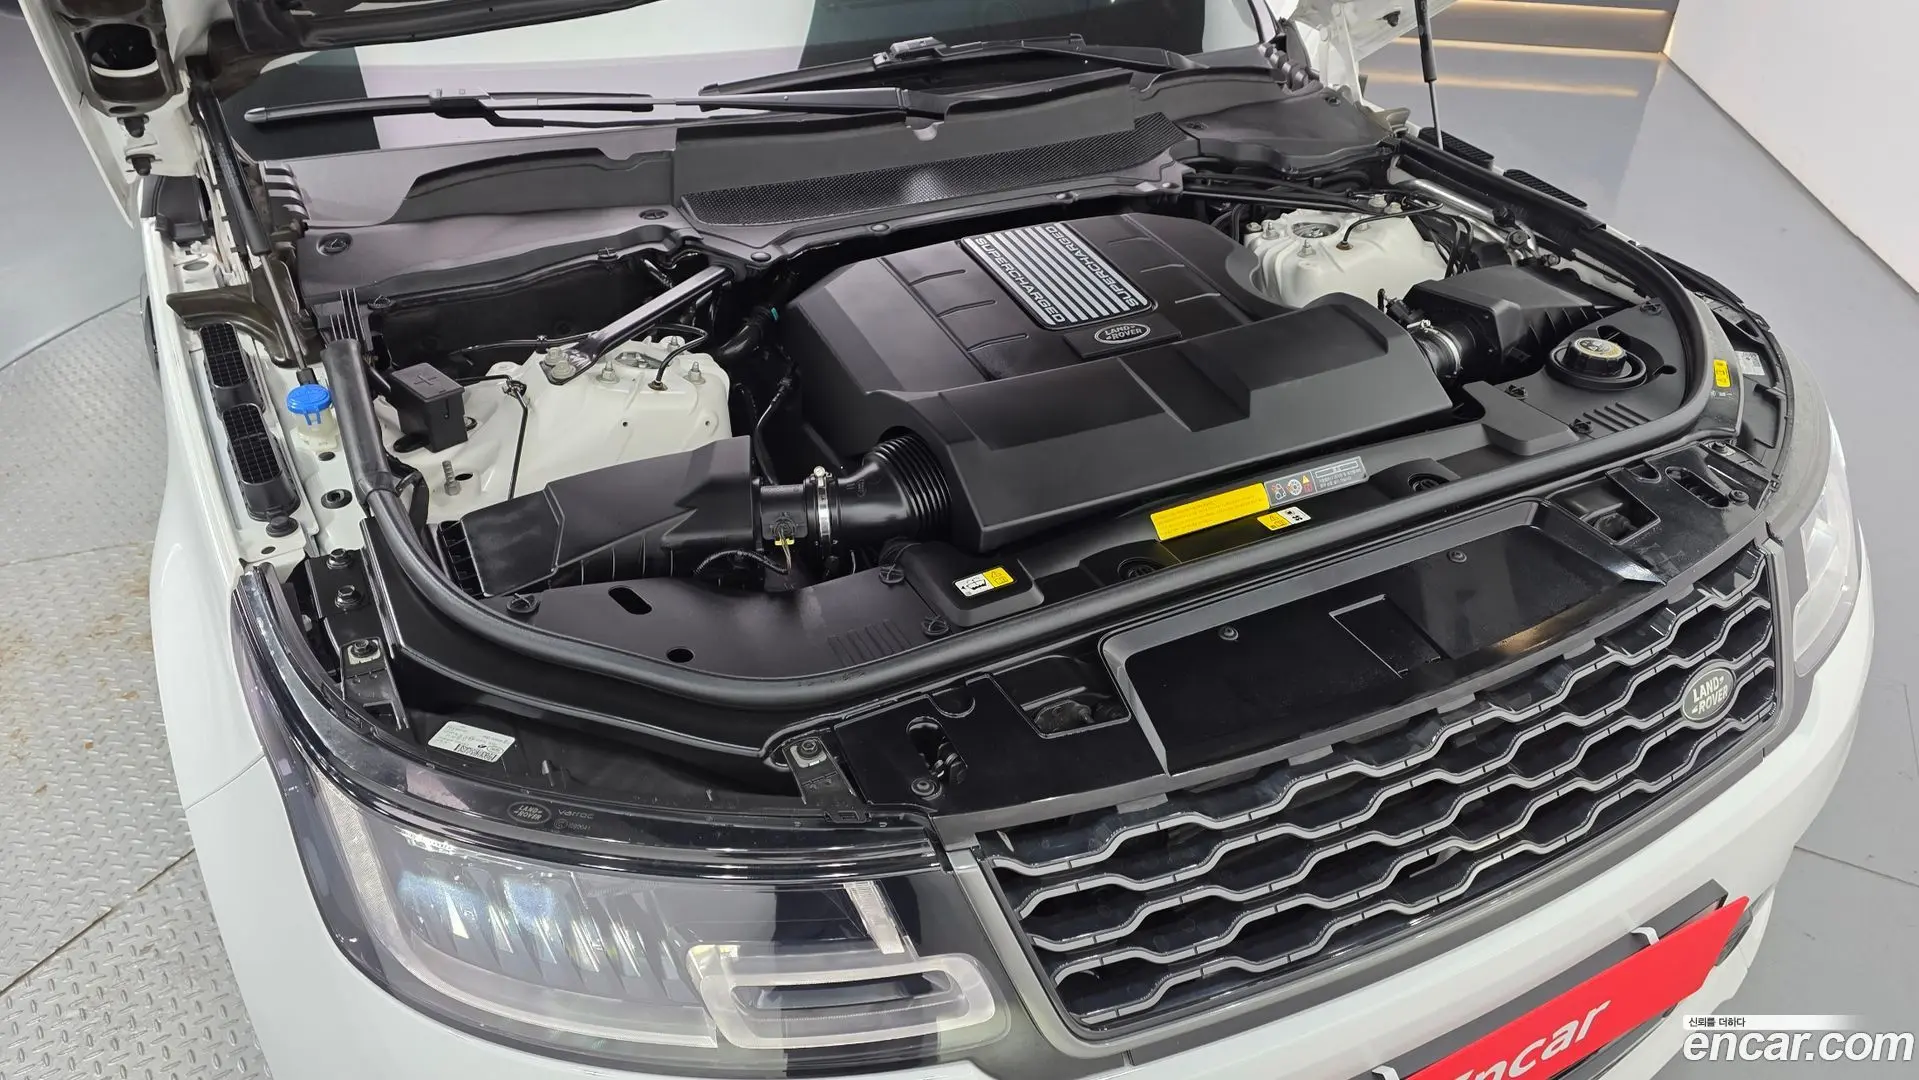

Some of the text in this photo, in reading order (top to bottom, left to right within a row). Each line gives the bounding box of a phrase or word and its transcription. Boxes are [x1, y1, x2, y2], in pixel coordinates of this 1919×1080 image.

[975, 237, 1066, 323] SUPERCHARGED
[1045, 225, 1139, 308] SUPERCHARGED
[1105, 325, 1130, 336] LAND
[1111, 328, 1143, 340] ROVER
[1692, 676, 1720, 704] LAND
[1698, 684, 1729, 715] ROVER
[517, 810, 543, 821] ROVER
[518, 804, 539, 815] LAND
[1454, 1000, 1611, 1080] ncar
